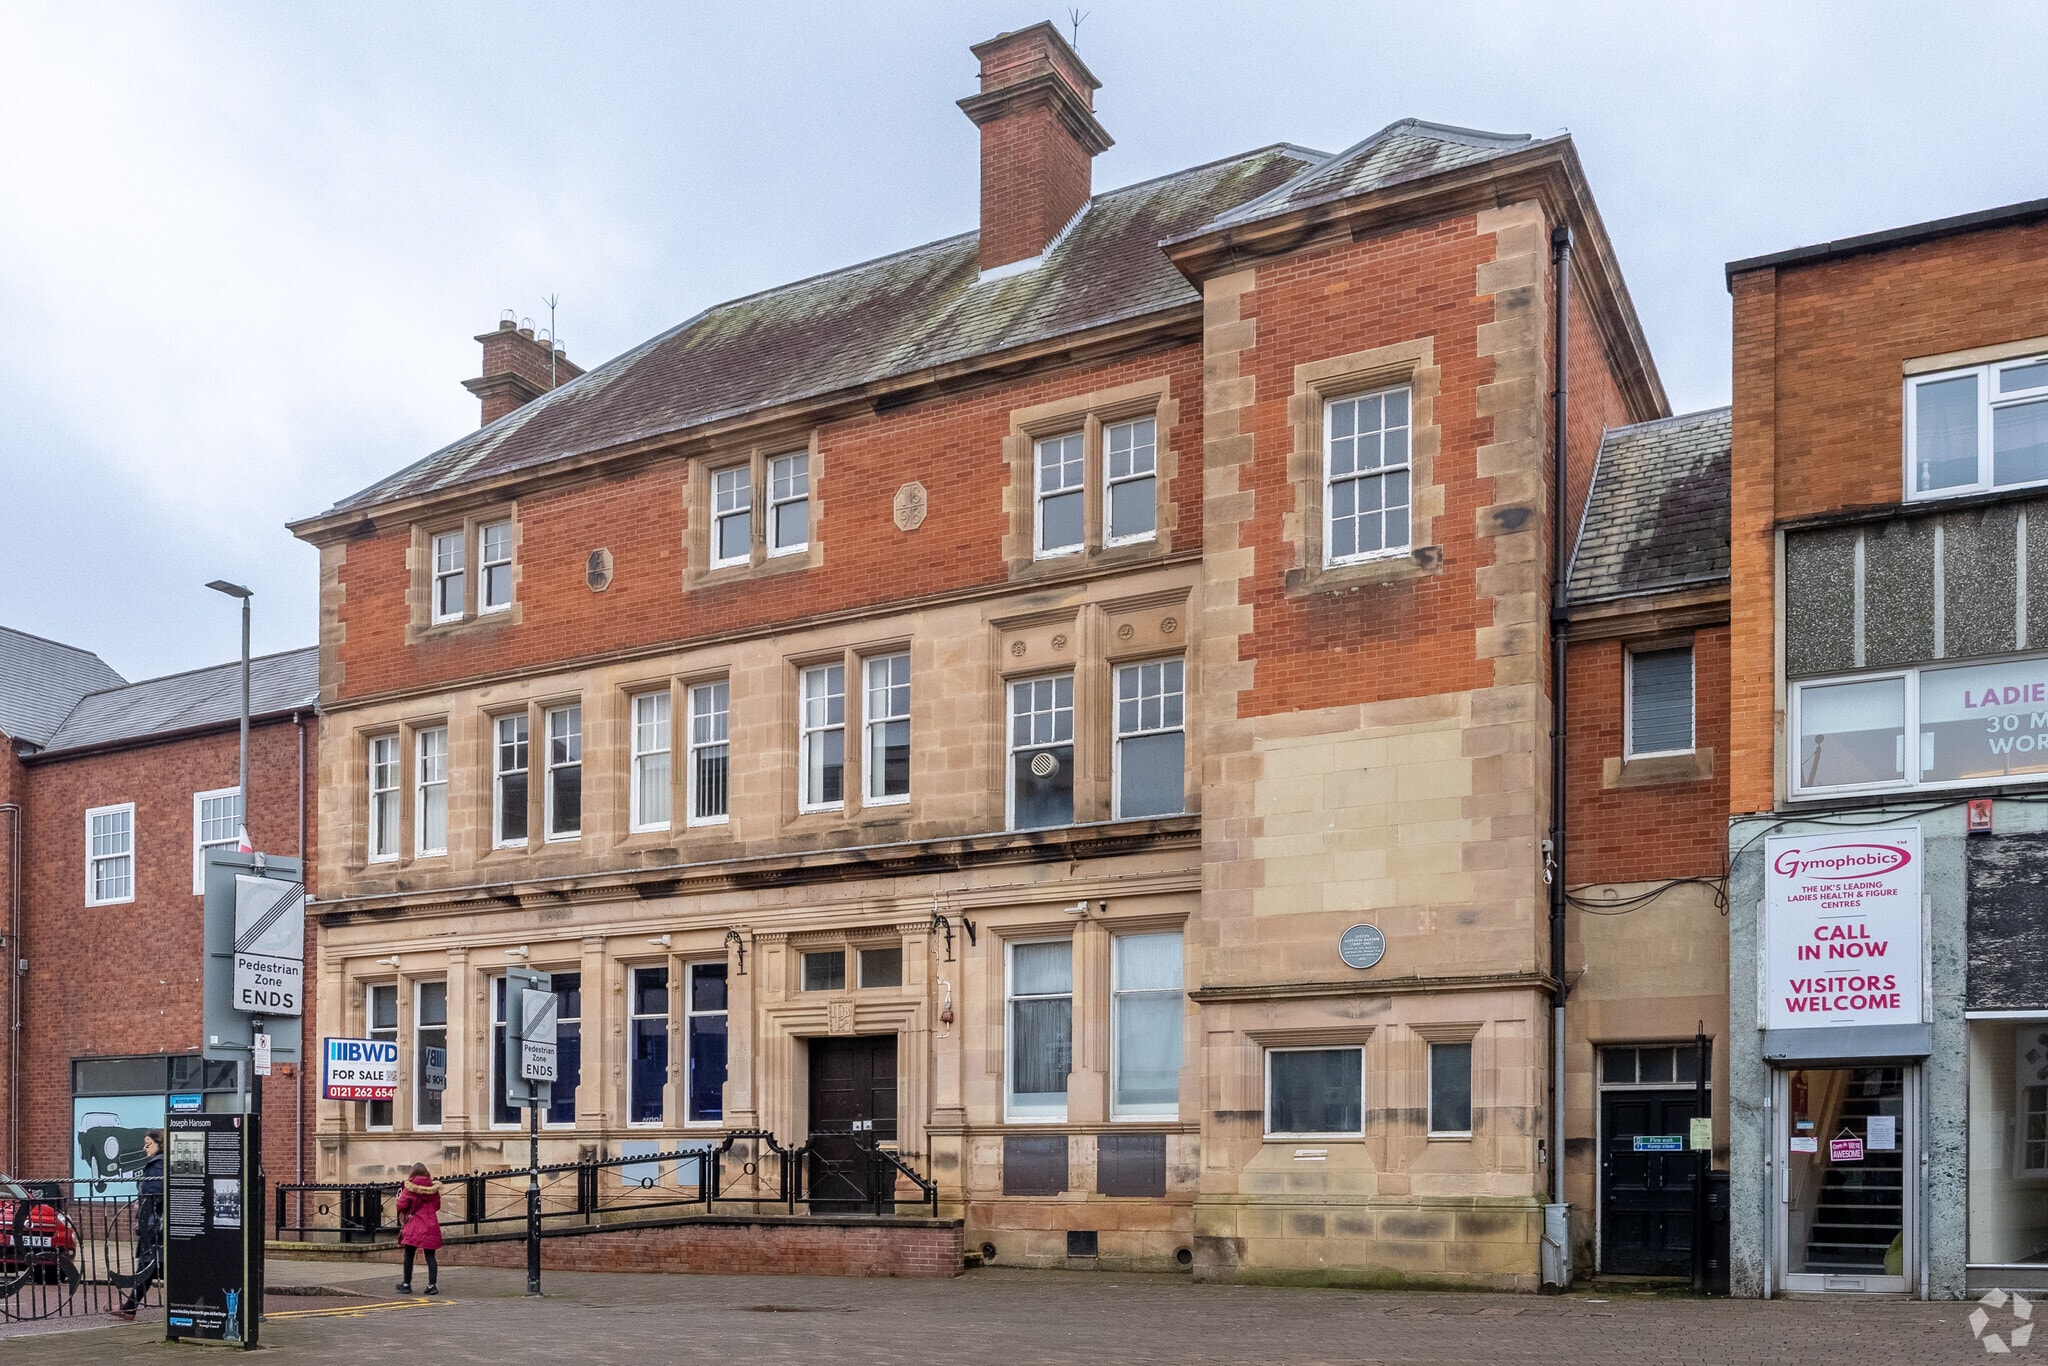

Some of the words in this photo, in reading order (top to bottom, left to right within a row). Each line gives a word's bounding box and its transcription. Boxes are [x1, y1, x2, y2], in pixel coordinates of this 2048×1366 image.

[1964, 683, 2045, 709] LADIE
[1986, 713, 2020, 734] 30
[1988, 734, 2048, 755] WOR
[1774, 849, 1899, 879] Gymophobics
[1801, 885, 1818, 893] THE
[1820, 884, 1841, 892] UK'S
[1843, 881, 1883, 890] LEADING
[1787, 894, 1818, 902] LADIES
[1820, 892, 1854, 900] HEALTH
[1856, 890, 1864, 898] &
[1865, 889, 1898, 897] FIGURE
[1821, 900, 1861, 909] CENTRES
[1813, 924, 1871, 942] CALL
[1798, 944, 1821, 961] IN
[1829, 941, 1888, 959] NOW
[238, 958, 299, 976] Pedestrian
[254, 974, 283, 987] Zone
[1789, 974, 1896, 994] VISITORS
[242, 988, 294, 1009] ENDS
[1785, 993, 1900, 1013] WELCOME
[524, 1044, 555, 1054] Pedestrian
[532, 1053, 547, 1062] Zone
[332, 1069, 355, 1080] FOR
[359, 1070, 384, 1081] SALE
[526, 1063, 553, 1077] ENDS
[330, 1087, 351, 1097] 0121
[354, 1087, 373, 1098] 262
[169, 1118, 189, 1128] Joseph
[189, 1119, 211, 1127] Hansom
[1832, 1149, 1861, 1159] AWESOME
